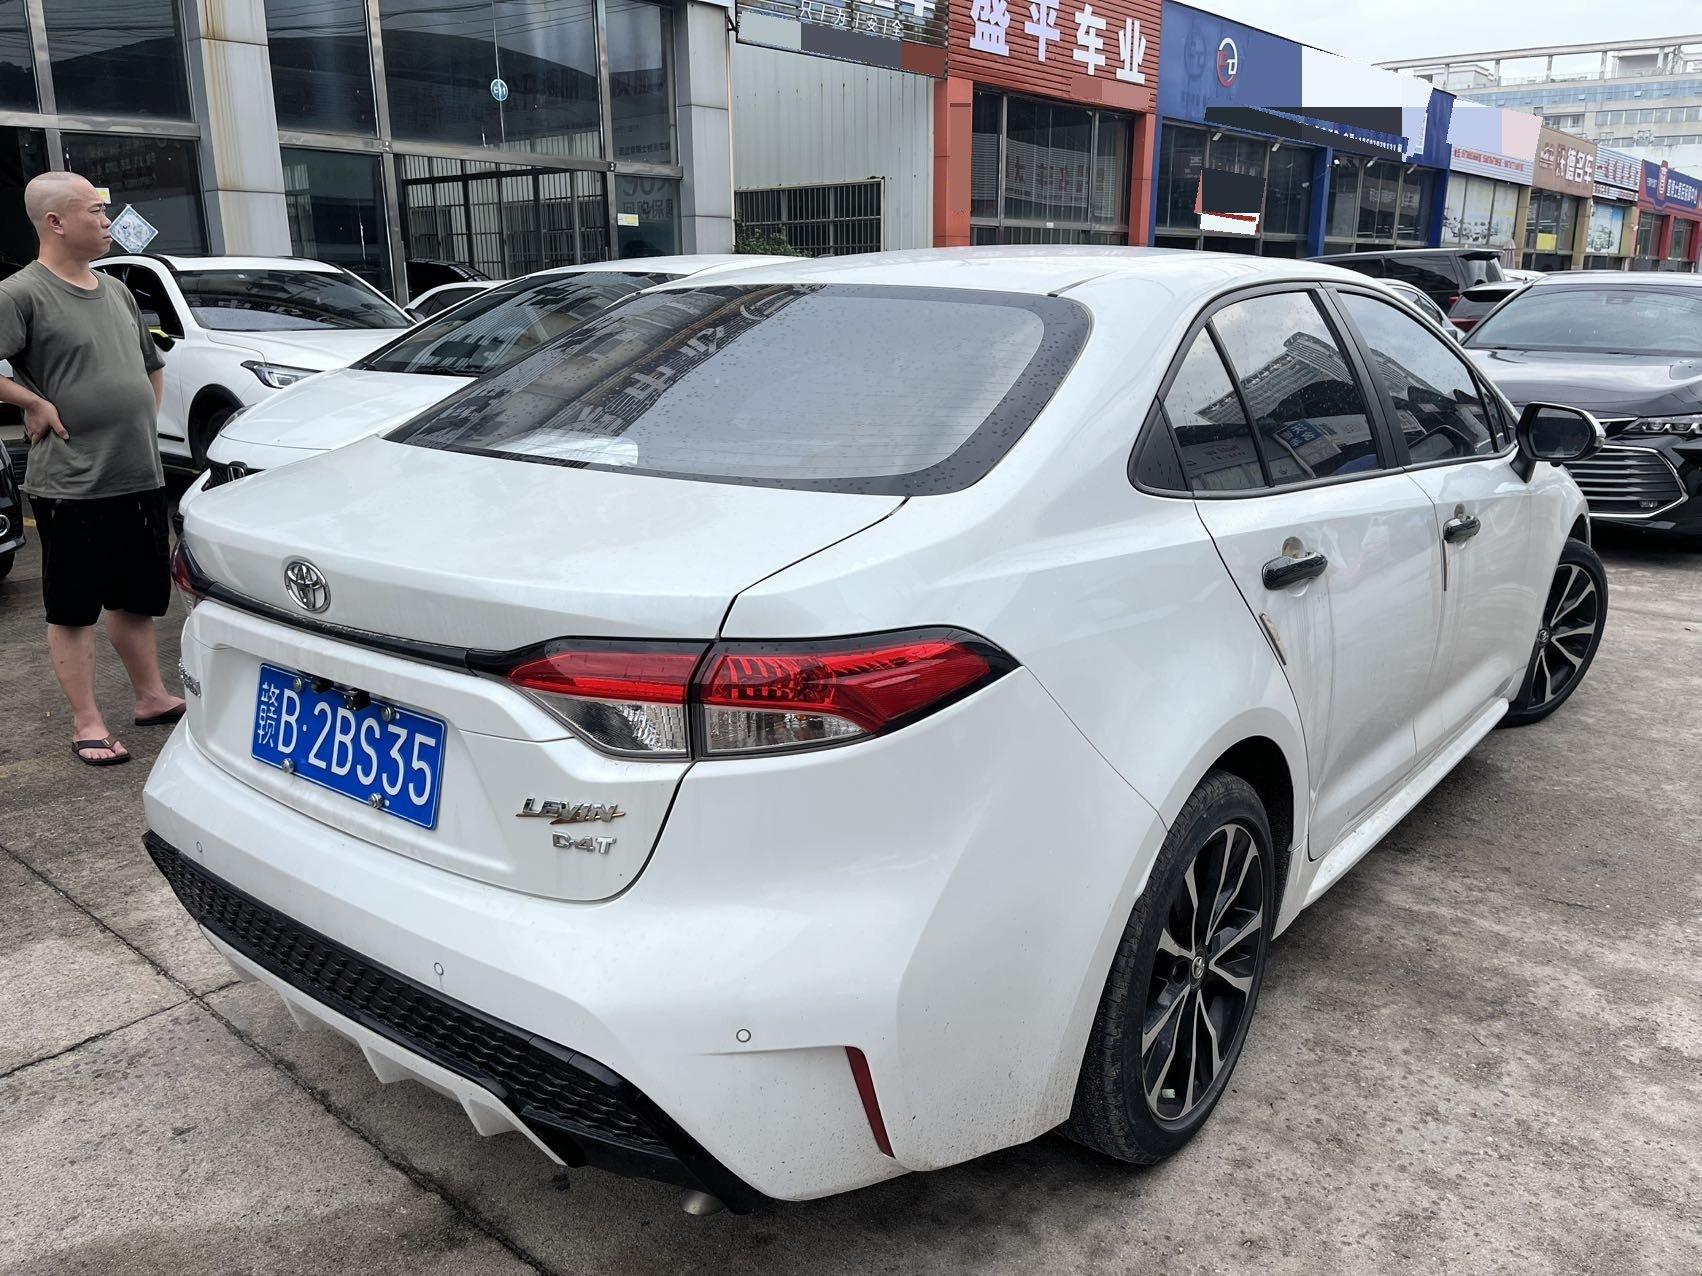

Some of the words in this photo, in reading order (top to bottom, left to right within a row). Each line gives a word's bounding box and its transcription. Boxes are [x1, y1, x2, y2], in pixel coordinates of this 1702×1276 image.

[969, 0, 1146, 84] 盛平车业
[521, 797, 618, 823] LEVIN
